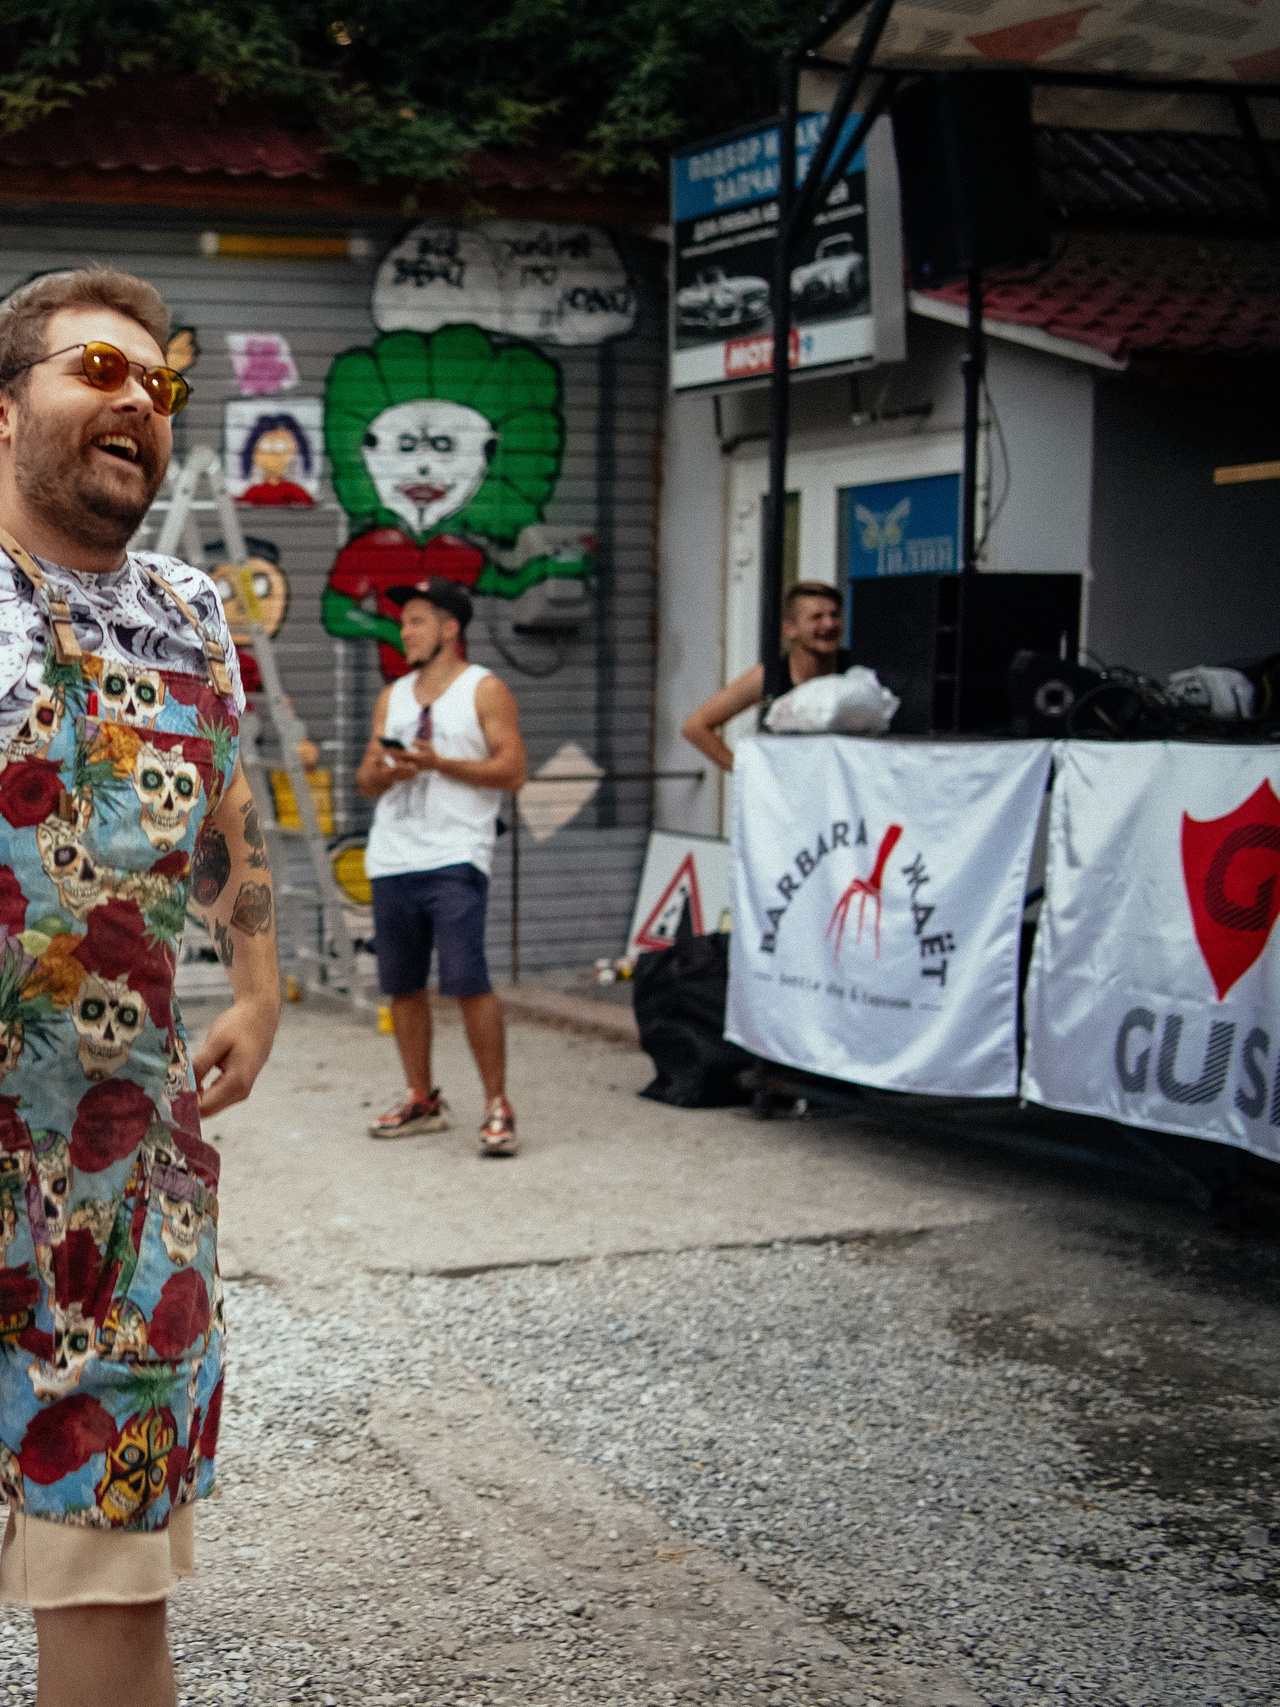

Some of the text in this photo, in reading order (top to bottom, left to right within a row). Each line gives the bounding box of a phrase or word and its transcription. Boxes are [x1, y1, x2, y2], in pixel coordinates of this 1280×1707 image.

[761, 817, 868, 954] BARBARA
[901, 851, 957, 988] ЖАЁТ
[1204, 822, 1280, 932] G
[1114, 1006, 1280, 1127] GUS
